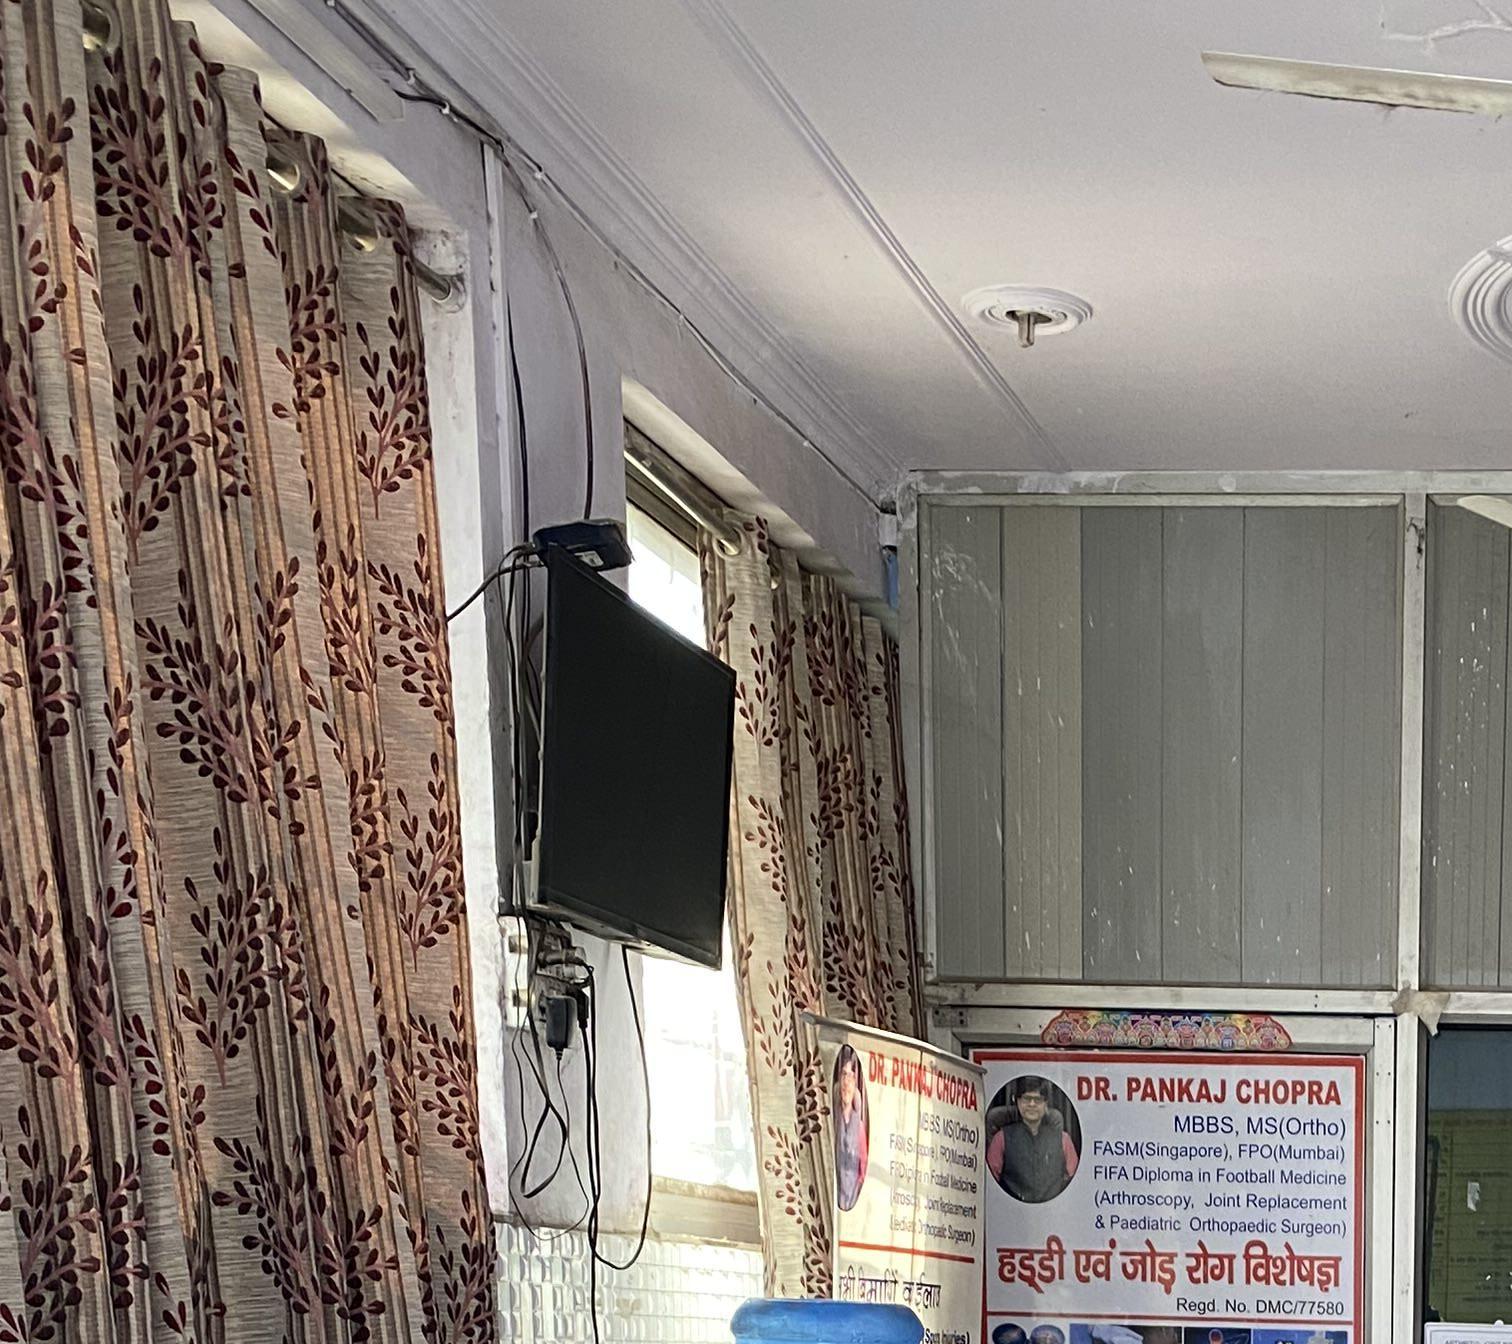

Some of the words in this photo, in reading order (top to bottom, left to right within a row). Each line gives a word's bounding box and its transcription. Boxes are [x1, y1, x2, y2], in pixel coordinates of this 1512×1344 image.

[868, 1051, 887, 1086] DR.
[936, 1069, 978, 1111] CHOPRA
[1076, 1076, 1118, 1101] DR.
[1126, 1077, 1226, 1104] PANKAJ
[1235, 1079, 1342, 1106] CHOPRA
[1174, 1115, 1240, 1137] MBBS,
[1246, 1117, 1347, 1139] MS(Ortho)
[1093, 1140, 1233, 1162] FASM(Singapore),
[1237, 1142, 1346, 1163] FPO(Mumbai)
[1093, 1165, 1129, 1181] FIFA
[1132, 1166, 1193, 1186] Diploma
[1197, 1168, 1212, 1183] in
[1215, 1168, 1276, 1185] Football
[1280, 1169, 1347, 1186] Medicine
[1094, 1191, 1195, 1210] (Arthroscopy,
[1204, 1192, 1242, 1208] Joint
[1246, 1193, 1347, 1213] Replacement
[1095, 1215, 1106, 1230] &
[1110, 1214, 1181, 1231] Paediatric
[1189, 1216, 1277, 1236] Orthopaedic
[1281, 1218, 1347, 1238] Surgeon)
[996, 1234, 1066, 1294] हड्डी
[1072, 1237, 1115, 1282] एवं
[1119, 1237, 1178, 1294] जोड़
[1186, 1237, 1235, 1285] रोग
[1243, 1238, 1342, 1293] विशेषज्ञ
[1175, 1297, 1220, 1315] Regd.
[1224, 1299, 1251, 1314] No.
[1255, 1299, 1344, 1316] DMC/77580
